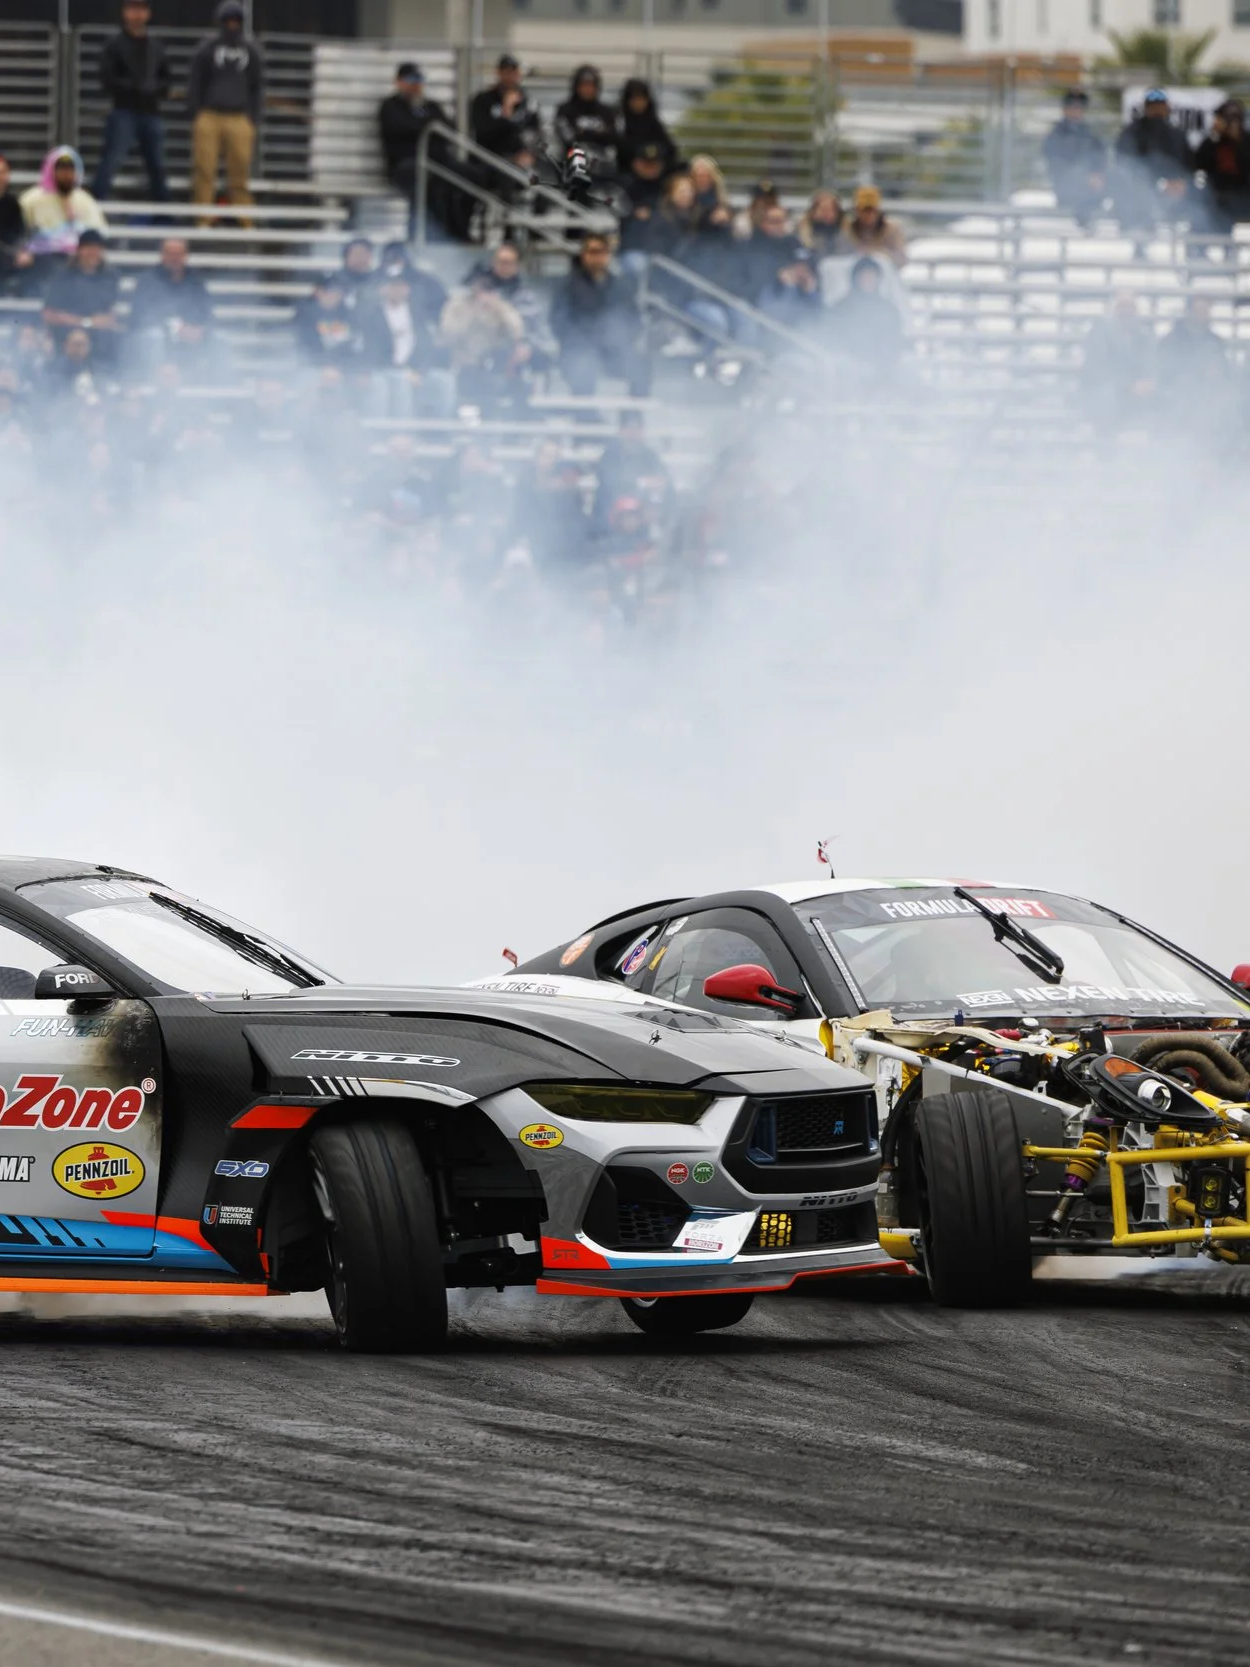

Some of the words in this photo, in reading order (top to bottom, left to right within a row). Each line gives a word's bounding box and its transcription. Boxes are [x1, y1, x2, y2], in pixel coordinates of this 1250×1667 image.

[880, 899, 982, 918] FORMULA
[1014, 986, 1128, 1002] NEXEN
[1126, 987, 1206, 1006] TIRE
[290, 1050, 461, 1067] NITTO
[525, 1131, 557, 1141] PENNZOIL
[65, 1158, 132, 1182] PENNZOIL
